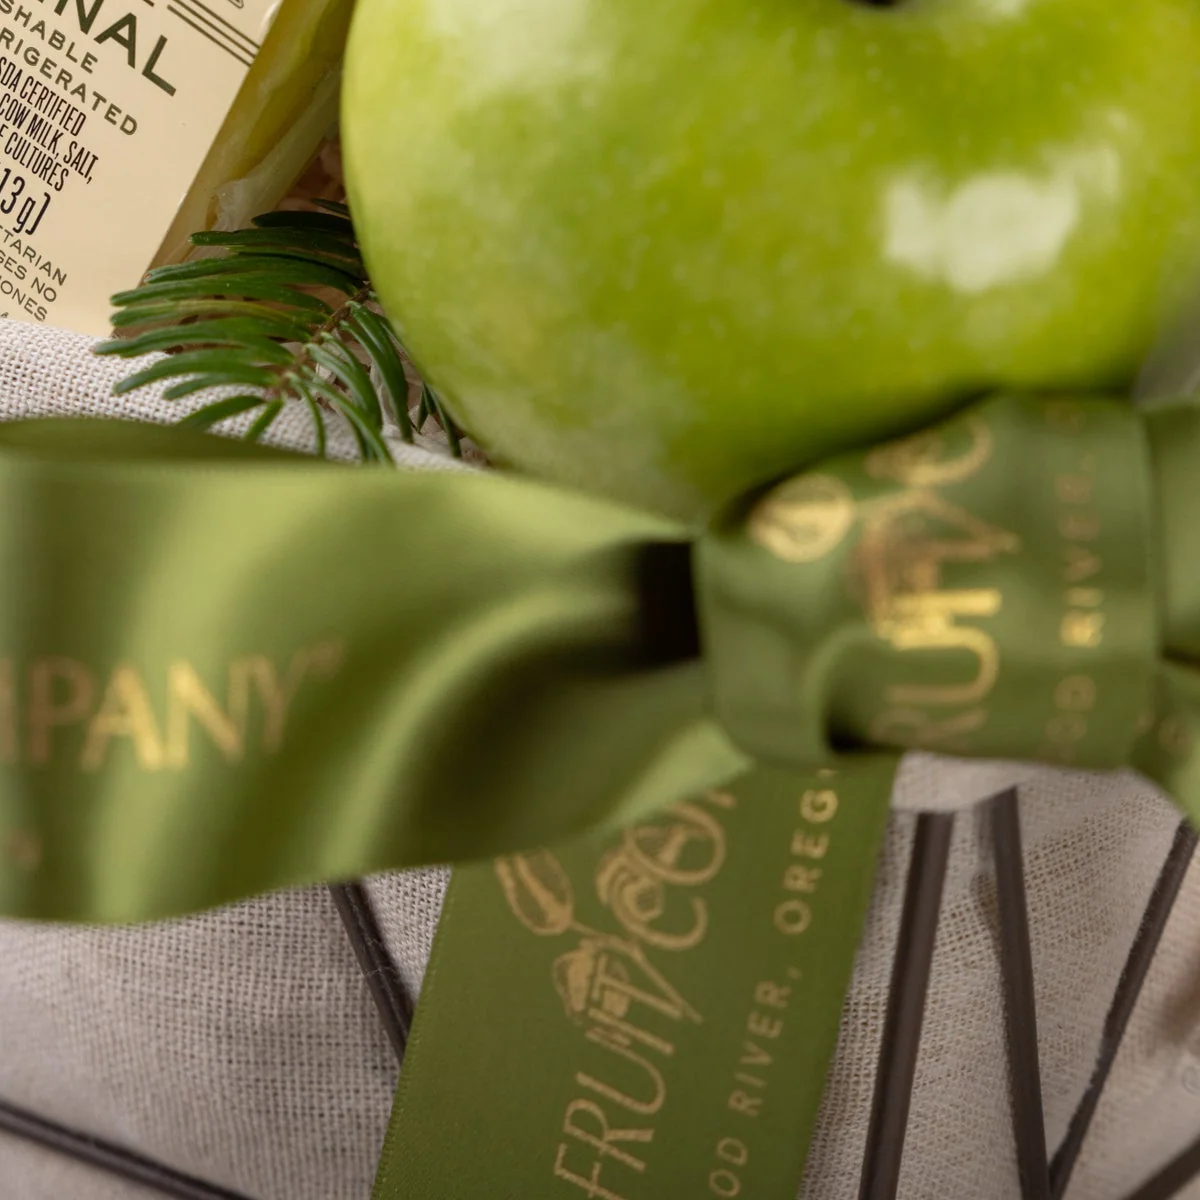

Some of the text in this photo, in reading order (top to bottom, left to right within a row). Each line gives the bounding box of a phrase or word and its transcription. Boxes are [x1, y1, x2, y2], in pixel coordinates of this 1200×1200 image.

[20, 75, 87, 137] CERTIFIED
[3, 131, 69, 191] CULTURES
[29, 113, 64, 158] MILK,
[63, 140, 99, 184] SALT,
[31, 277, 57, 303] NO
[728, 966, 802, 1117] RIVER,
[773, 768, 839, 935] OREG
